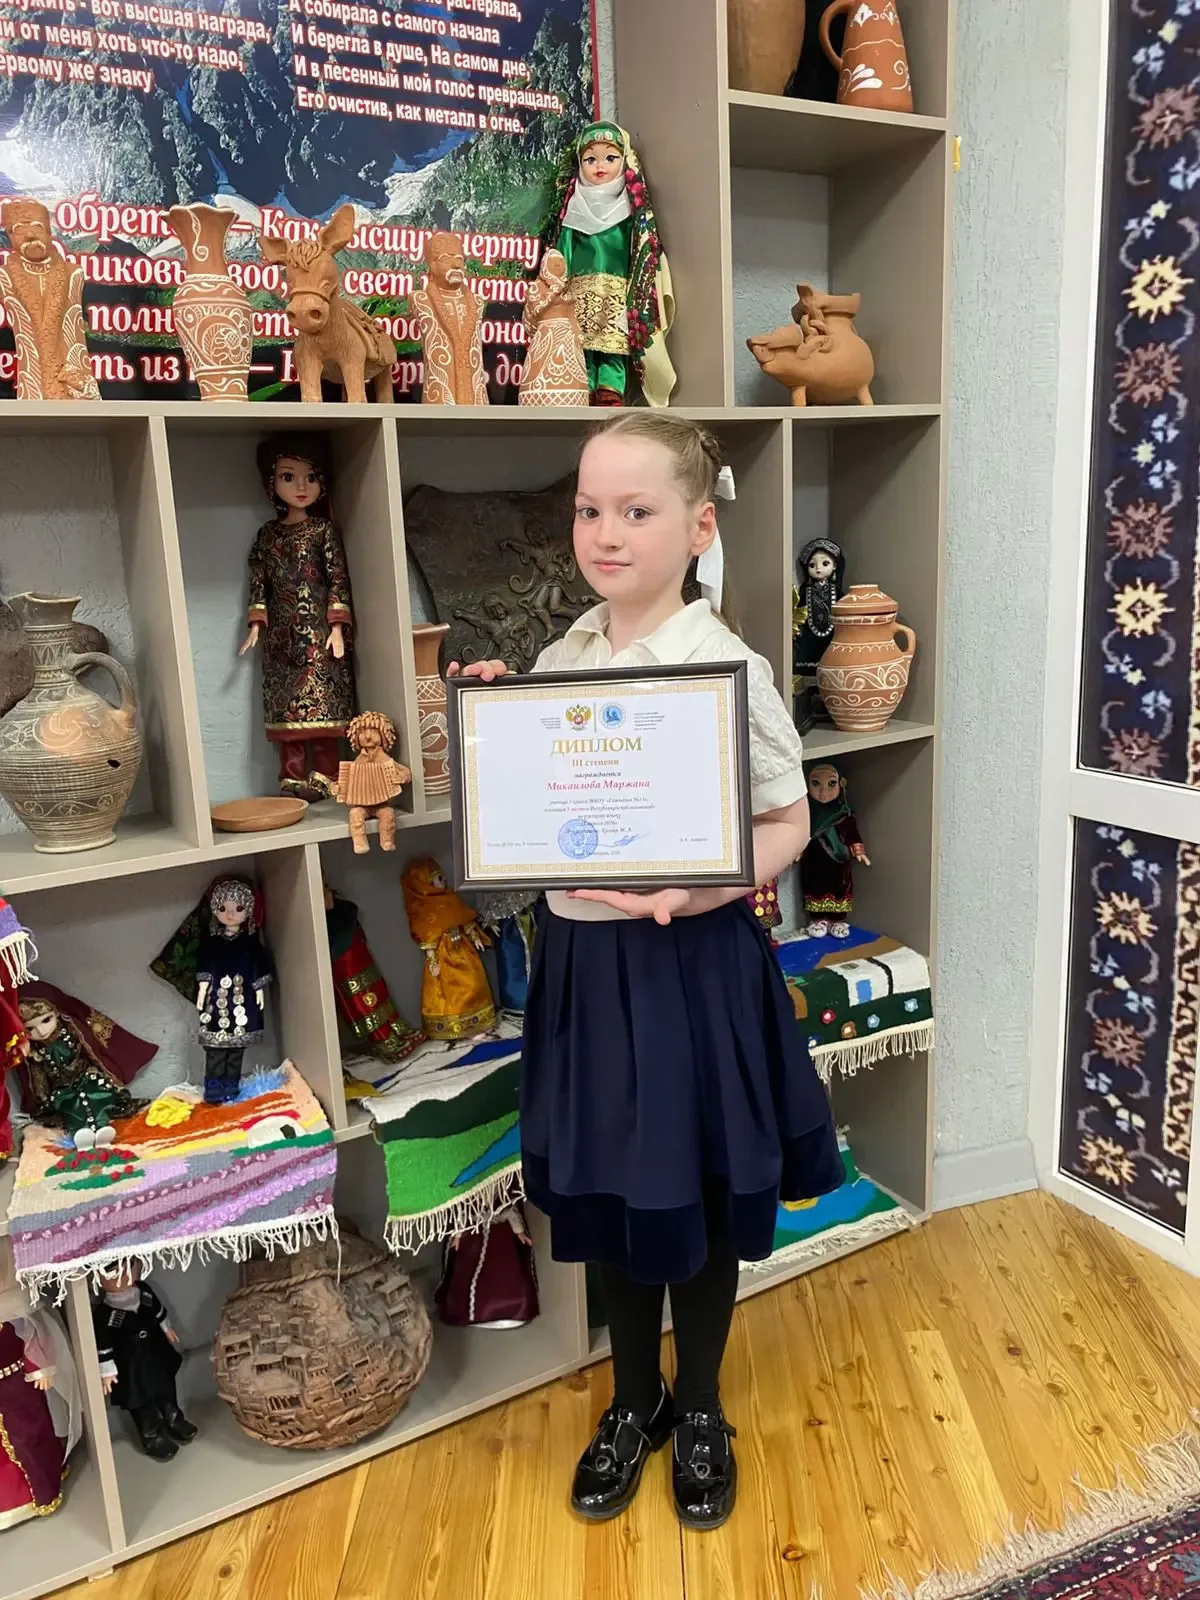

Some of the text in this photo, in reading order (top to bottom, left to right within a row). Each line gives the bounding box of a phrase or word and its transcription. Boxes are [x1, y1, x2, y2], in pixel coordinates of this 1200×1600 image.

[92, 0, 122, 18] вот
[125, 2, 195, 29] высшая
[198, 13, 272, 44] награда,
[304, 0, 379, 26] собирала
[381, 12, 391, 27] с
[394, 14, 447, 36] самого
[450, 24, 501, 45] начала
[20, 22, 40, 41] от
[45, 25, 93, 48] меня
[96, 32, 138, 53] хоть
[141, 37, 193, 61] что-то
[198, 45, 244, 73] надо,
[291, 23, 531, 81] И берегла в душе, На самом дне,
[0, 52, 153, 93] ервому же знаку
[294, 55, 564, 114] И в песенный мой голос превращала,
[297, 86, 524, 134] Его очистив, как металл в огне.
[344, 270, 414, 297] свет
[140, 354, 180, 381] из
[550, 736, 643, 757] ДИПЛОМ
[572, 759, 619, 767] III степени
[574, 771, 622, 780] награждается
[603, 779, 651, 791] Маржана
